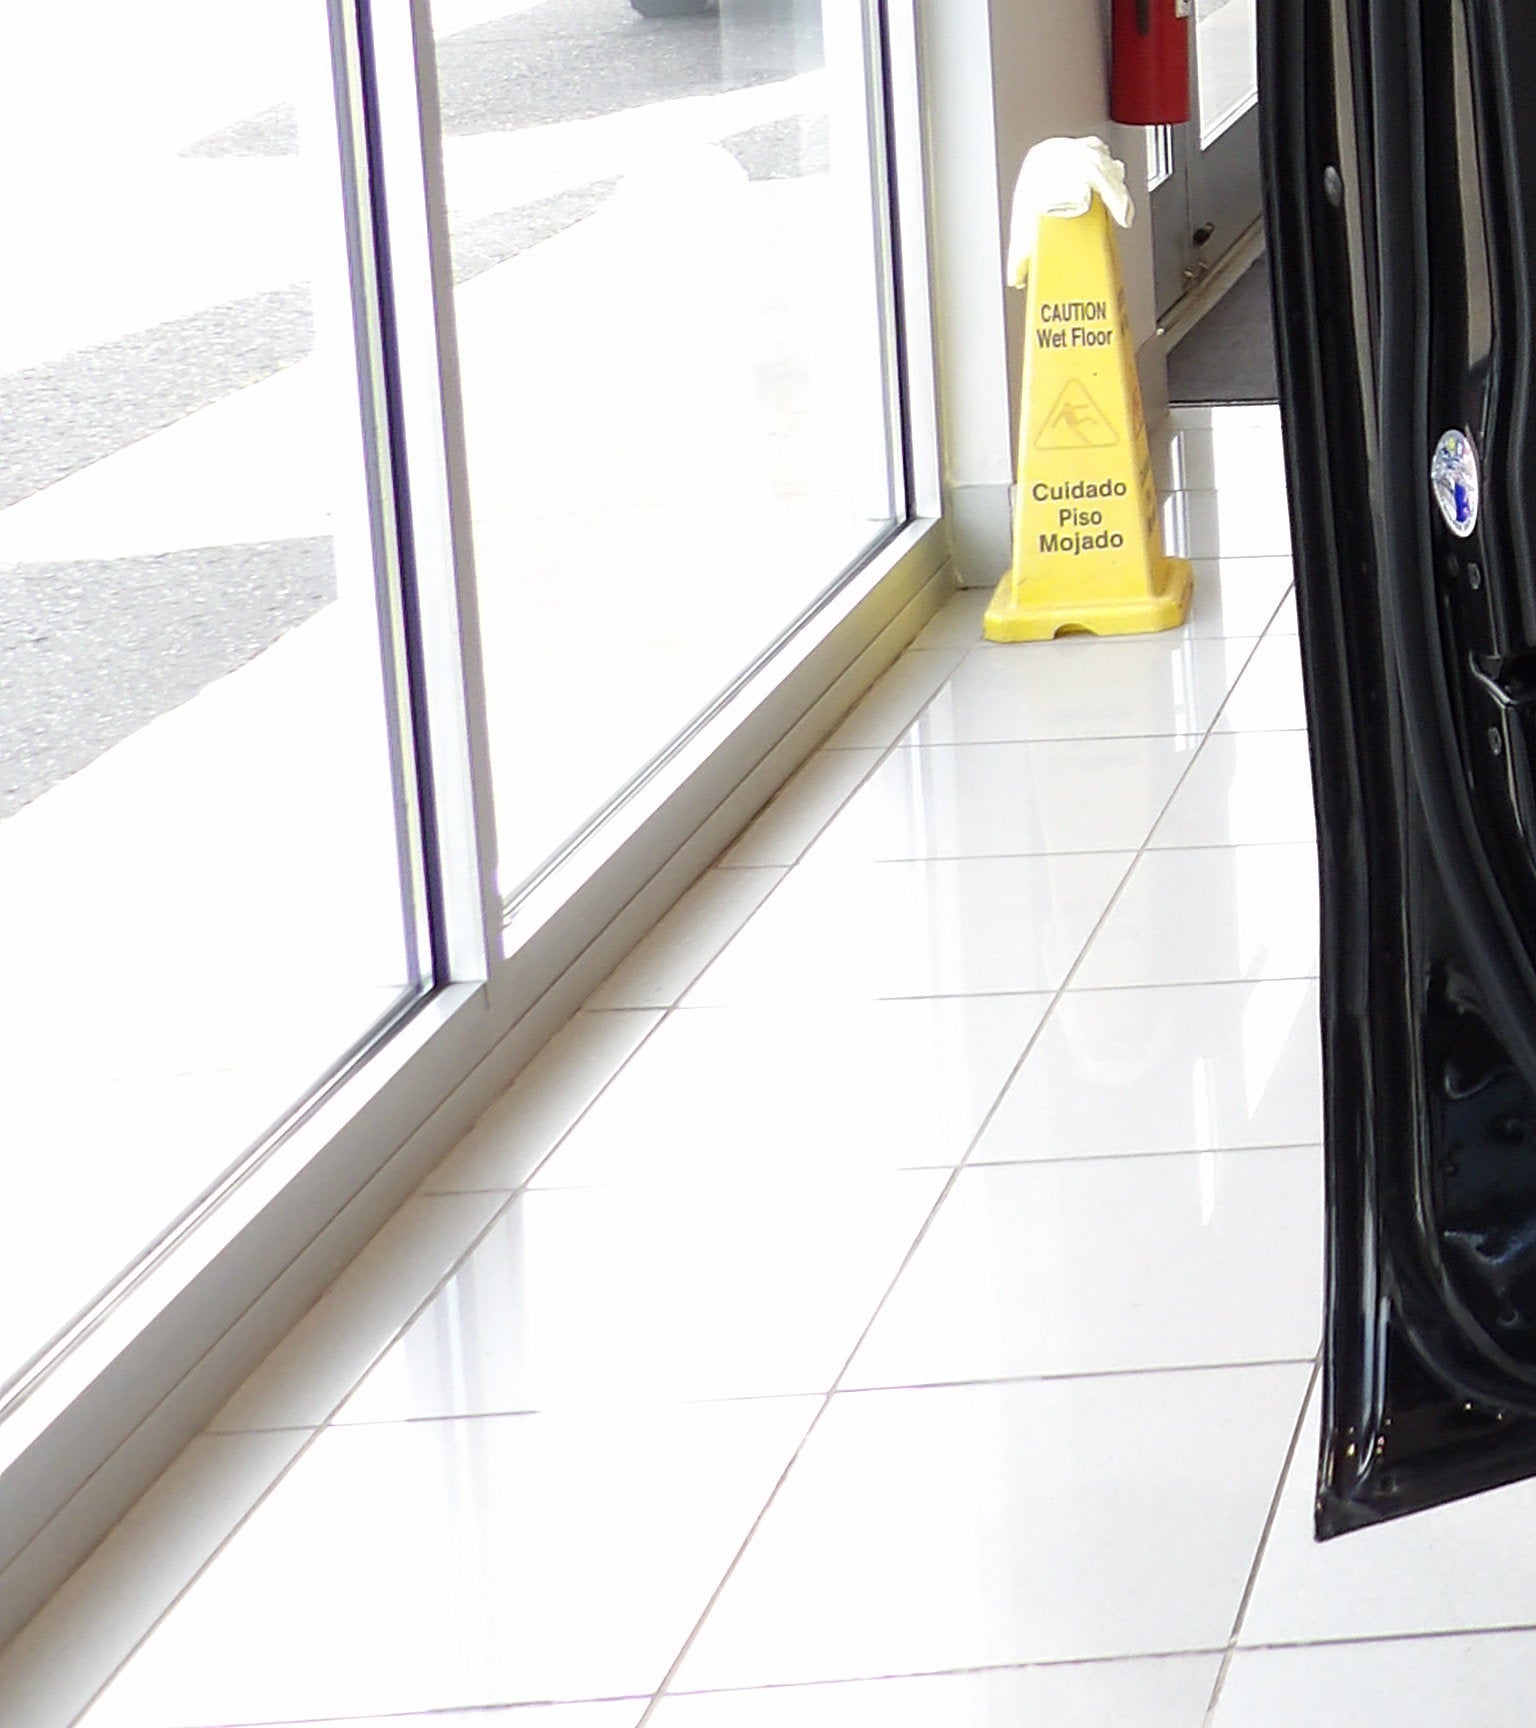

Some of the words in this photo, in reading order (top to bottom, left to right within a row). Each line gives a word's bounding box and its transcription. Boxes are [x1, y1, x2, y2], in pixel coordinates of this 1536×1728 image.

[1041, 301, 1107, 323] CAUTION
[1036, 328, 1067, 348] Wet
[1071, 327, 1113, 347] Floor
[1032, 478, 1127, 501] Cuidado
[1059, 508, 1102, 527] Piso
[1039, 530, 1123, 556] Mojado
